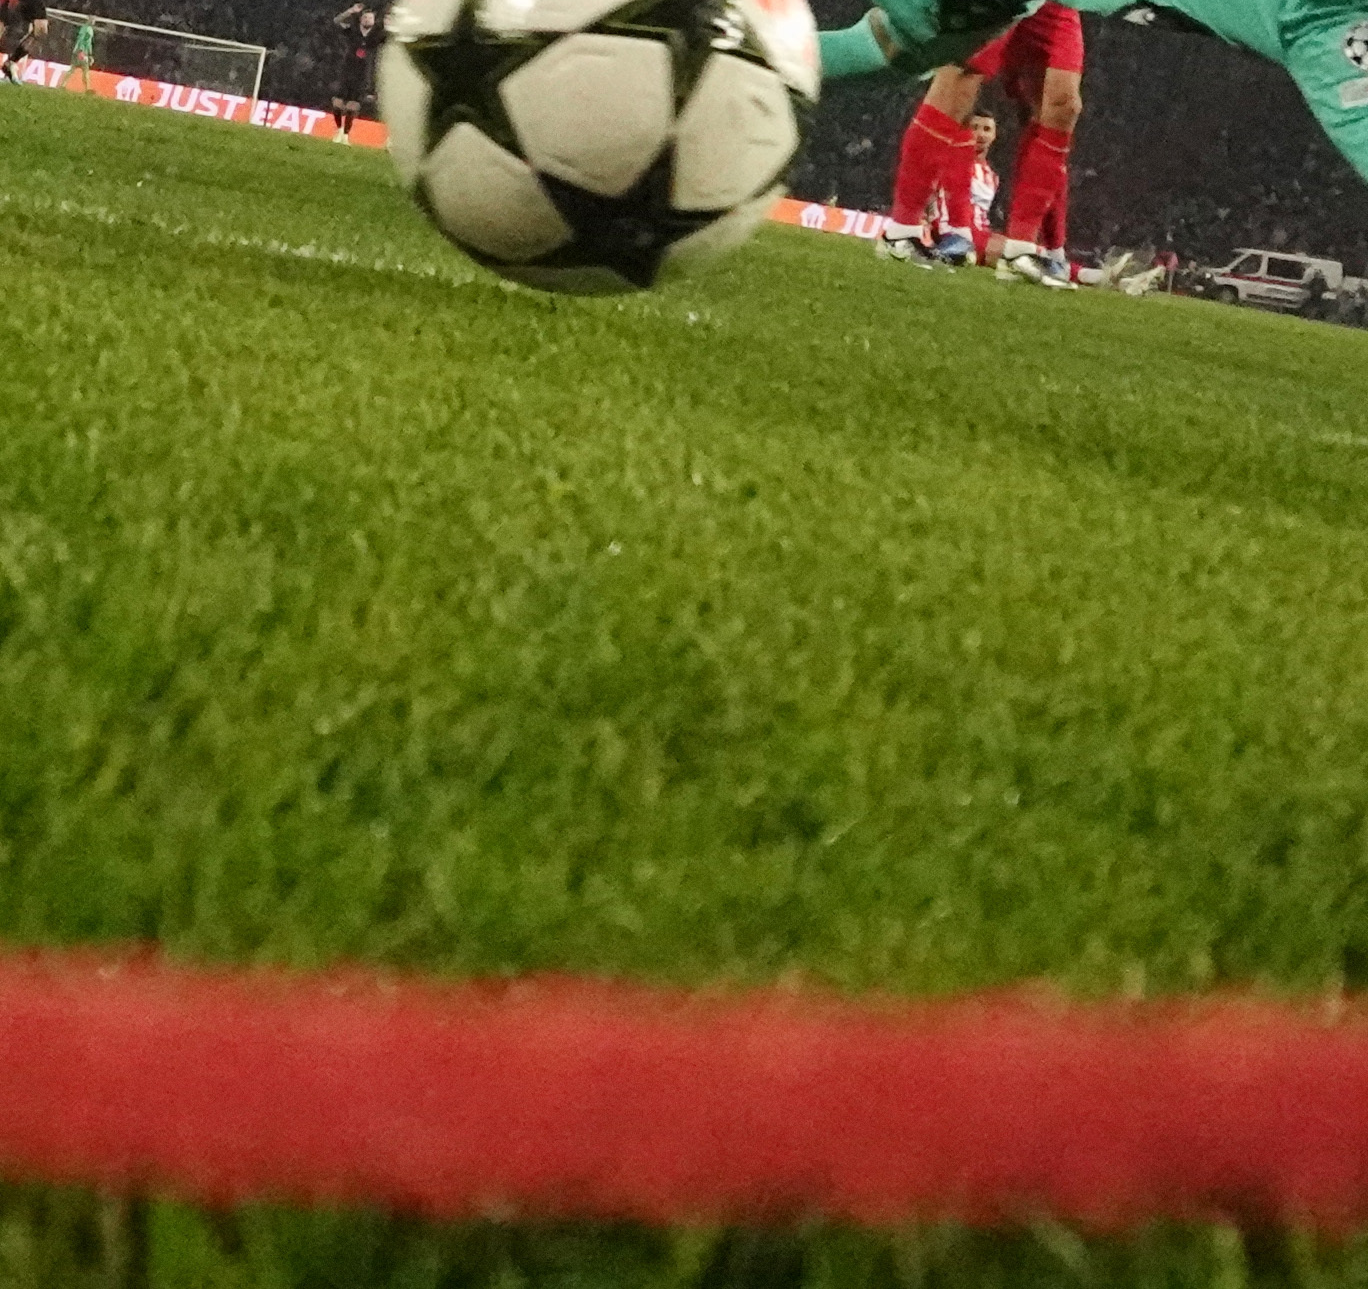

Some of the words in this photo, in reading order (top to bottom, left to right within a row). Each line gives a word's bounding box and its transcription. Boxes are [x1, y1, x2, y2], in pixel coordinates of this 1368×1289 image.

[152, 81, 247, 121] JUST
[249, 99, 327, 135] EAT
[839, 208, 892, 238] JU
